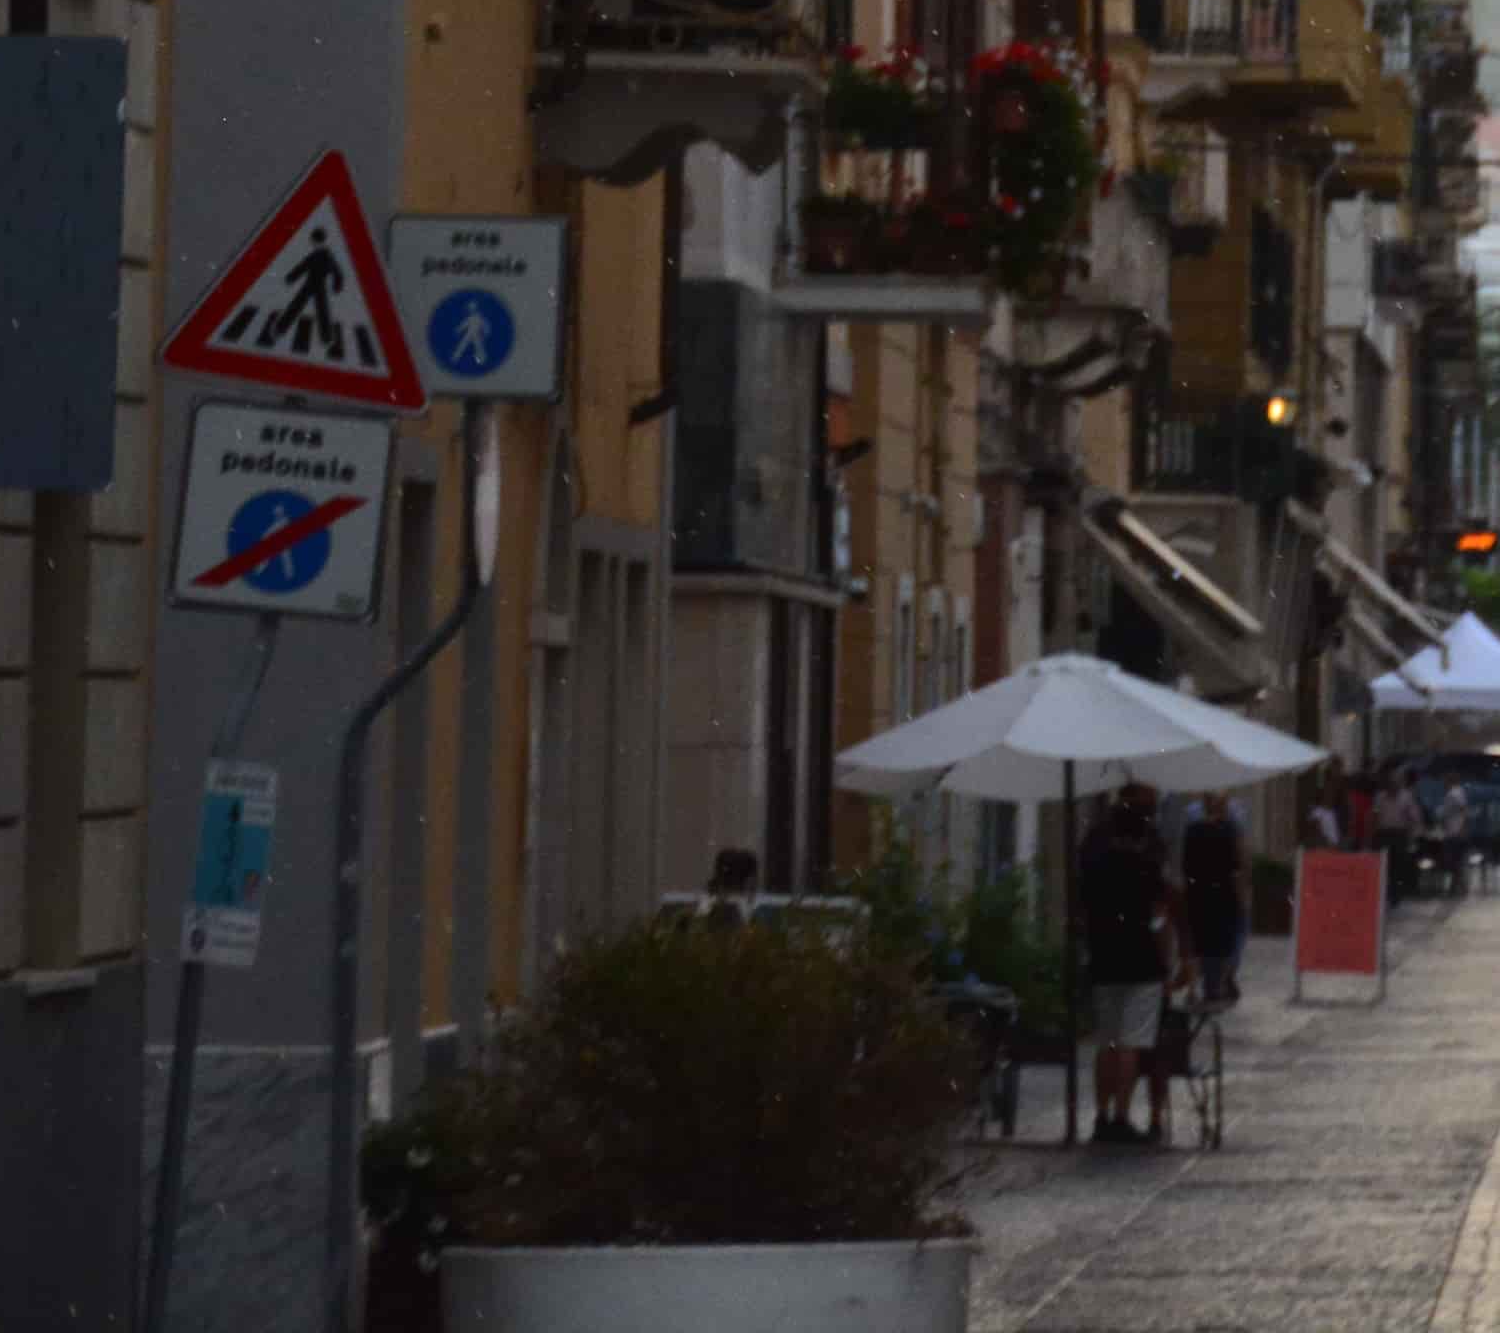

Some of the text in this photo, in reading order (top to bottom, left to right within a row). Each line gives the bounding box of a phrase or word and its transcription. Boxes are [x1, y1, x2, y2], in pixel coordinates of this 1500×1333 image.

[450, 231, 501, 248] area
[420, 255, 527, 279] pedonale
[258, 423, 324, 449] area
[219, 449, 357, 483] pedonale
